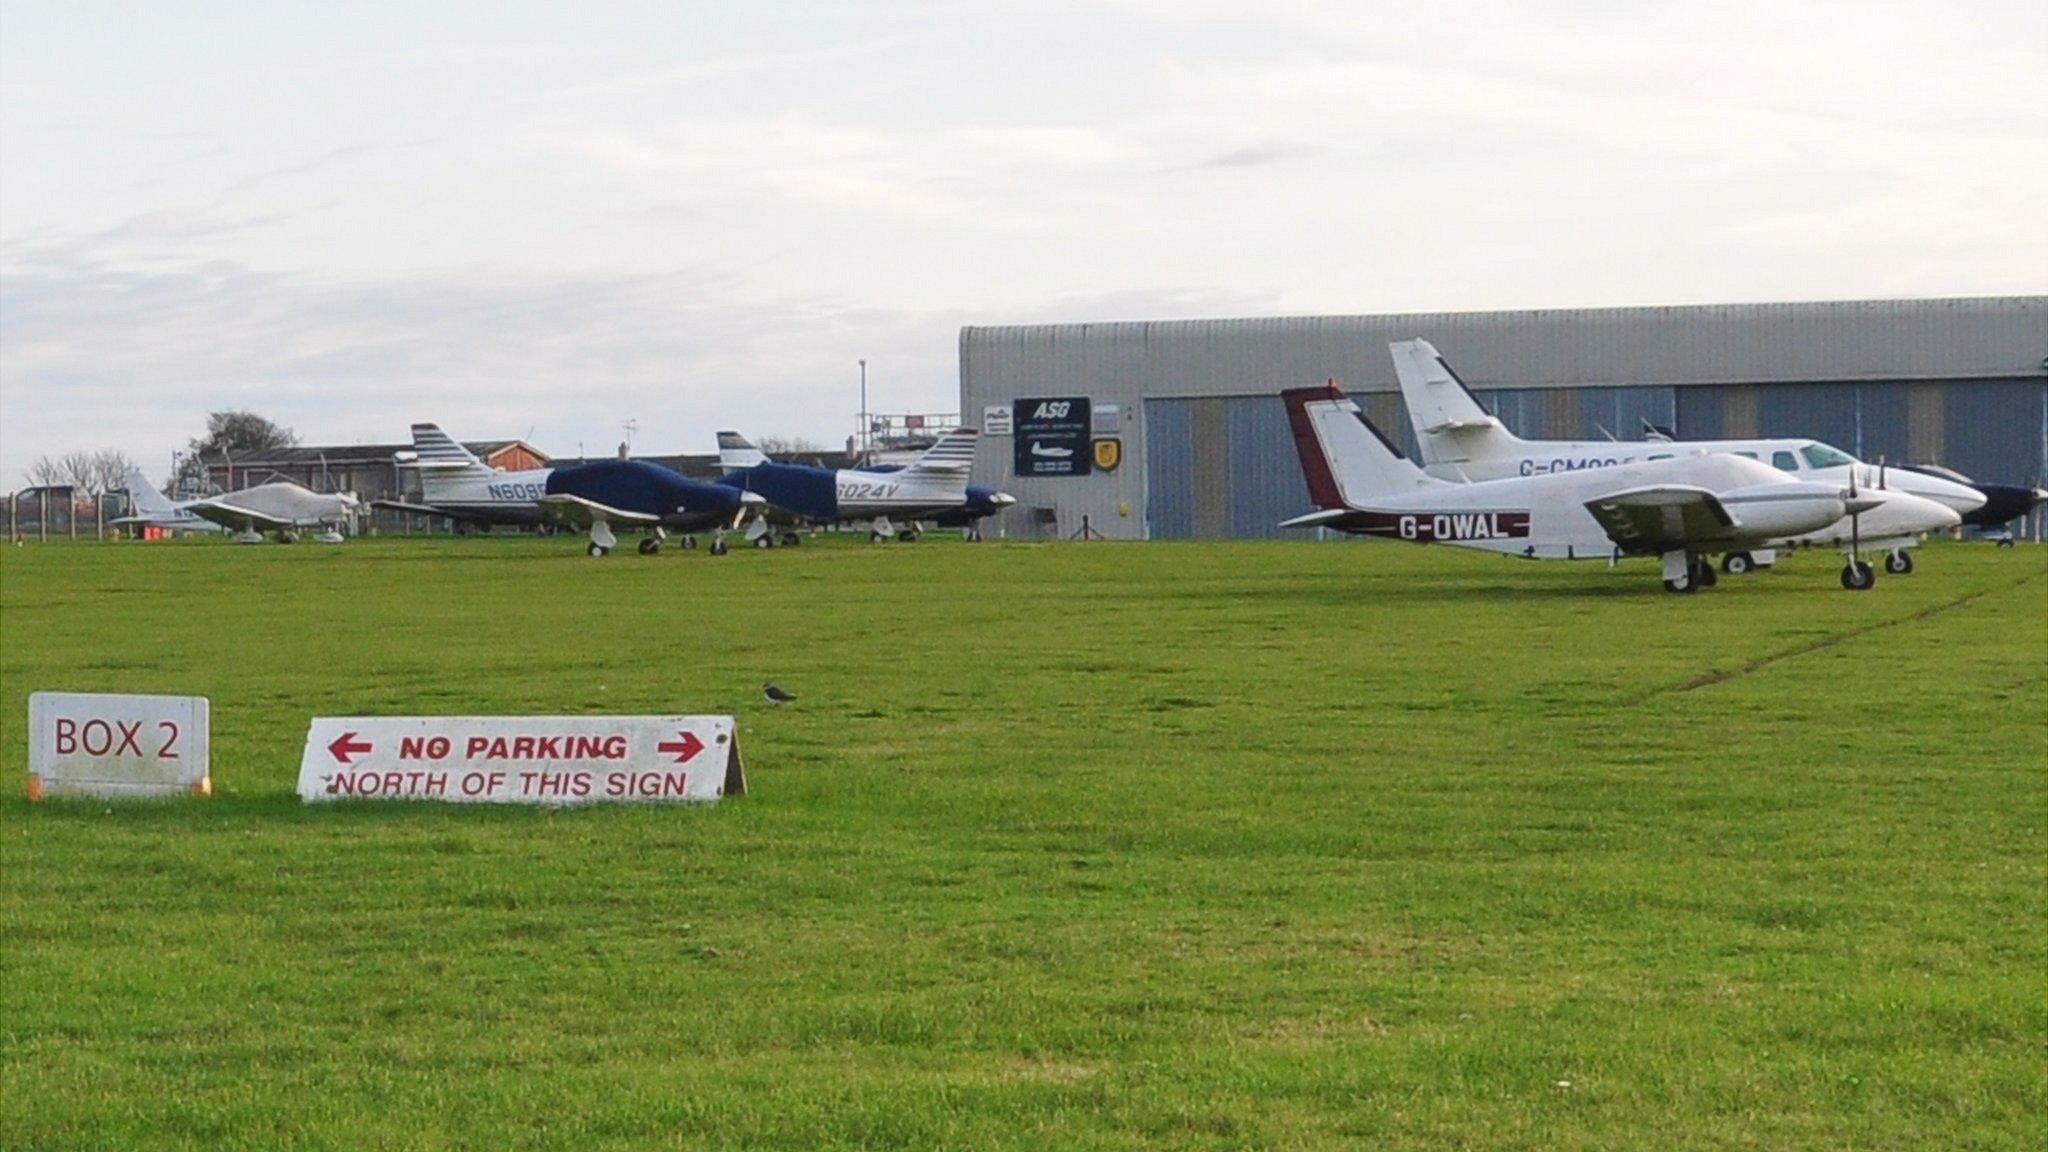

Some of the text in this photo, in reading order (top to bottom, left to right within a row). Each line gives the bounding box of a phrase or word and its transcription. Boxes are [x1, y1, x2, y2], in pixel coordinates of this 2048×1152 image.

[1399, 513, 1509, 540] G-OWAL
[56, 718, 180, 758] BOX 2
[399, 736, 627, 760] NO PARKING
[335, 772, 687, 796] NORTH OF THIS SIGN
